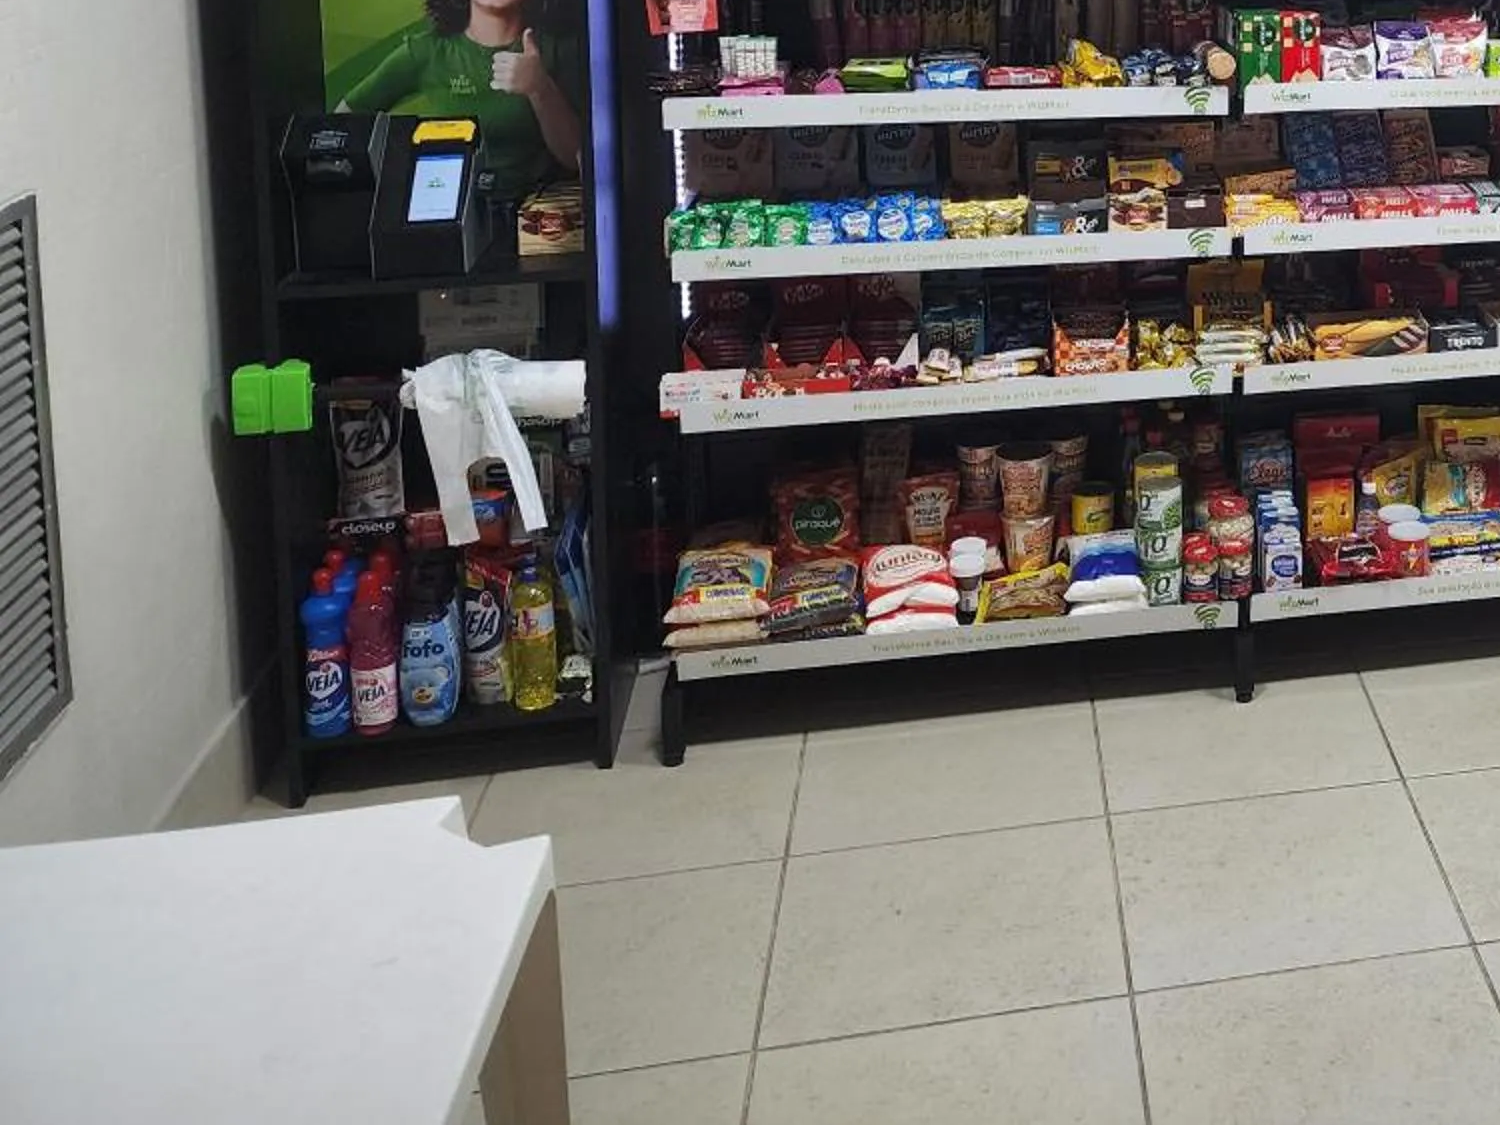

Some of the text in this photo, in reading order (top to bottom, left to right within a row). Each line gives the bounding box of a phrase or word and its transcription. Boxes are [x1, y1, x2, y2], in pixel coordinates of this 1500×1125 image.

[403, 641, 446, 659] fofo
[306, 672, 341, 693] VEJA
[356, 685, 386, 703] VEJA
